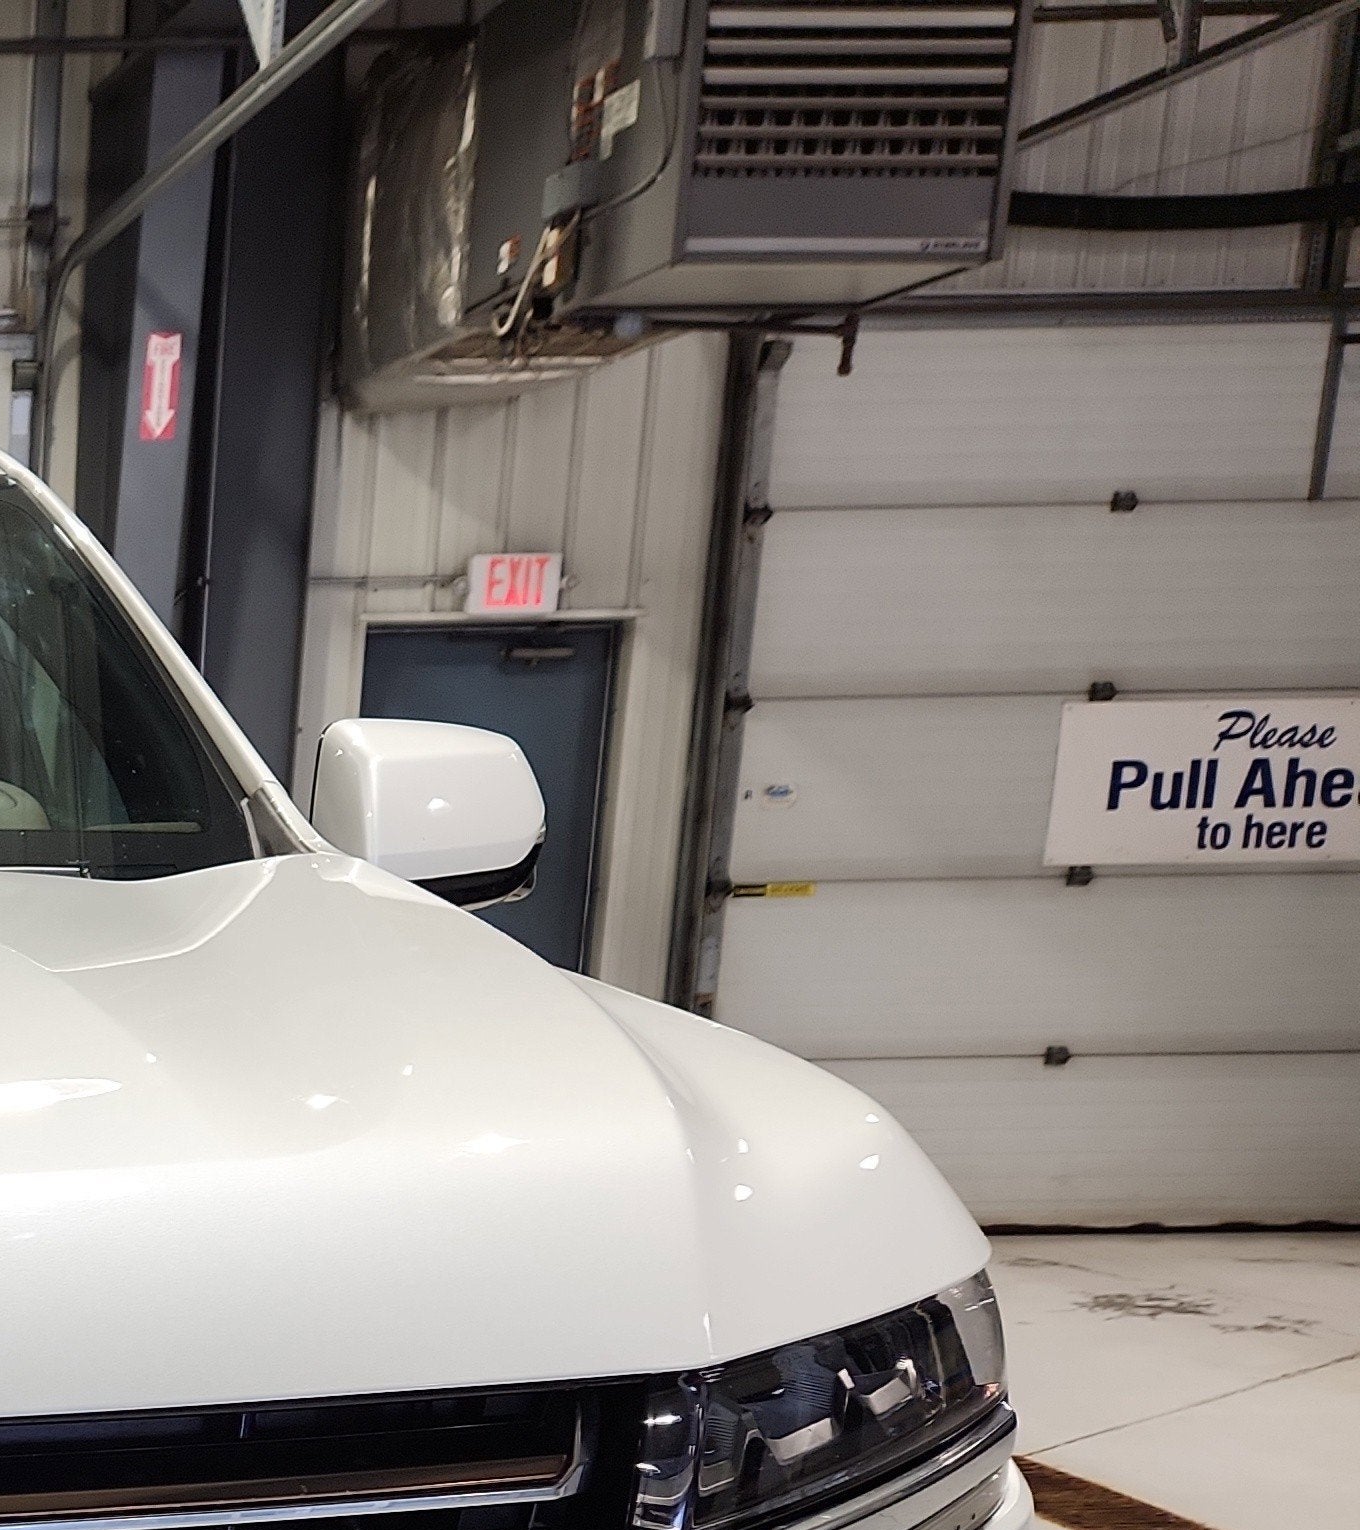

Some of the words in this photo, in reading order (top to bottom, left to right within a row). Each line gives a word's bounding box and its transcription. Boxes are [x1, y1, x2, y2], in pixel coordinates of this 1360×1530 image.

[485, 556, 551, 607] EXIT
[1213, 708, 1337, 751] Please
[1106, 758, 1219, 811] Pull
[1234, 757, 1360, 809] Ahe
[1196, 816, 1231, 850] to
[1241, 814, 1328, 849] here
